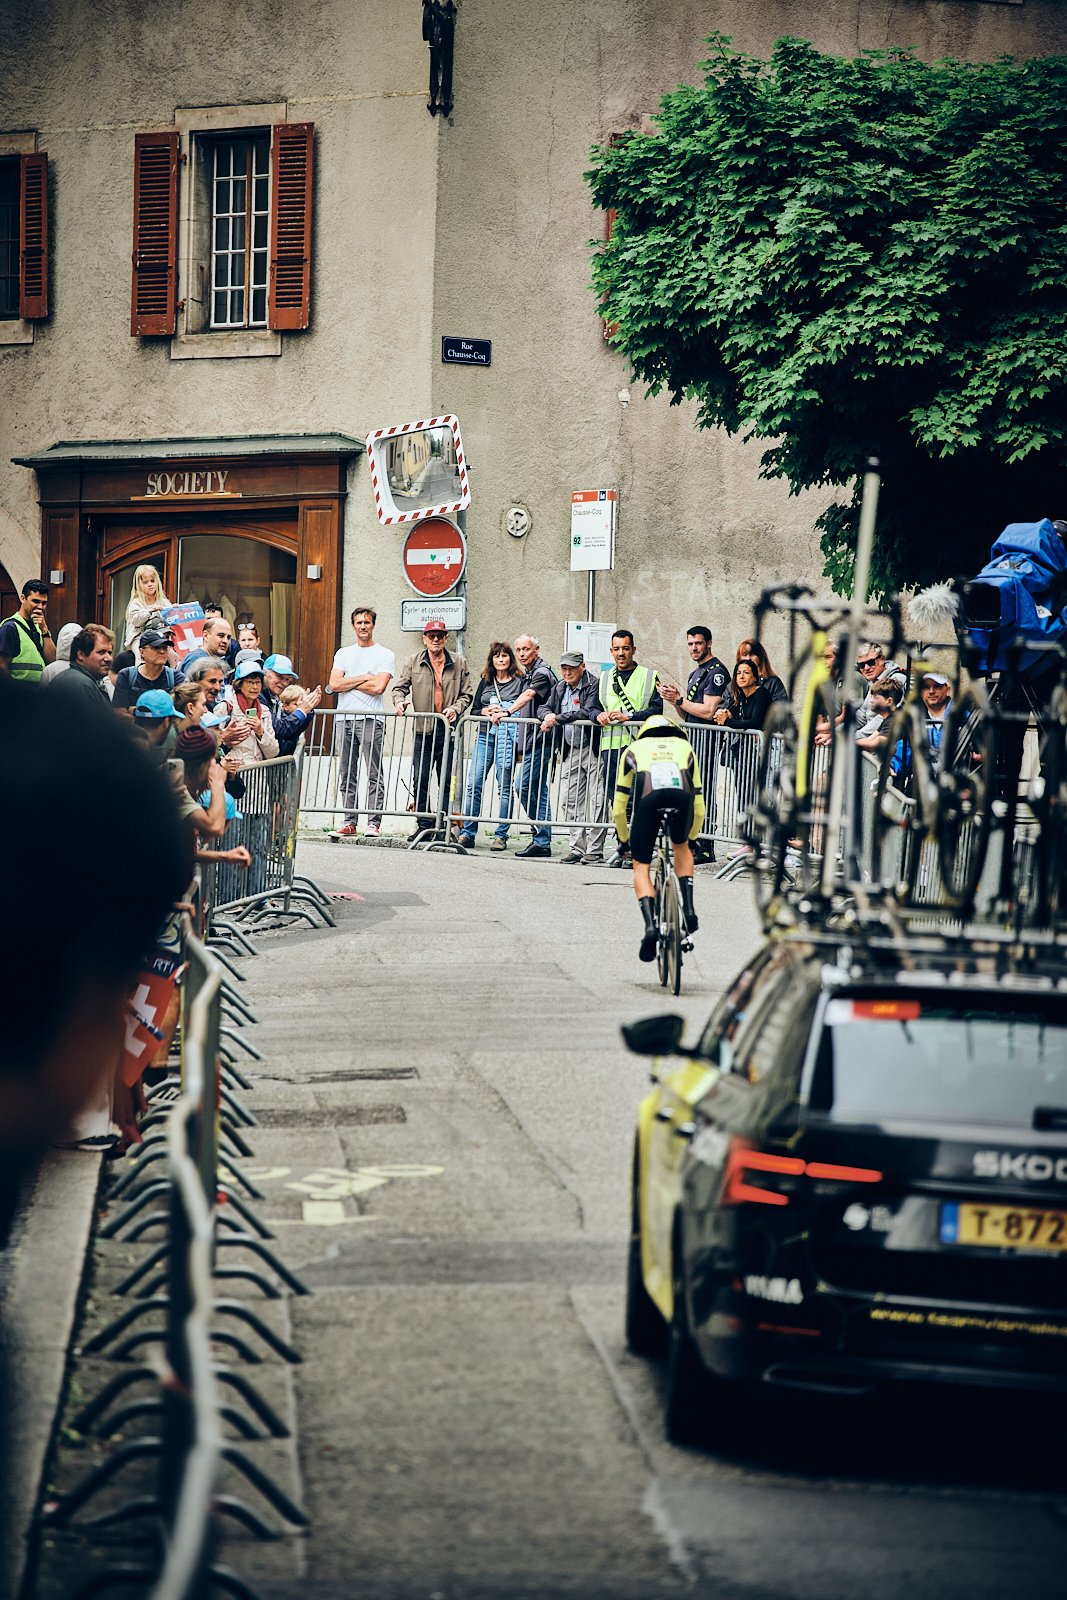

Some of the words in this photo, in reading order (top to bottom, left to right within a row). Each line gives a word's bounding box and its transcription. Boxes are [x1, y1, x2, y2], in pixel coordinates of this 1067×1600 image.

[461, 342, 473, 350] Rue
[447, 349, 486, 362] Chausse-Coq
[146, 470, 229, 495] SOCIETY
